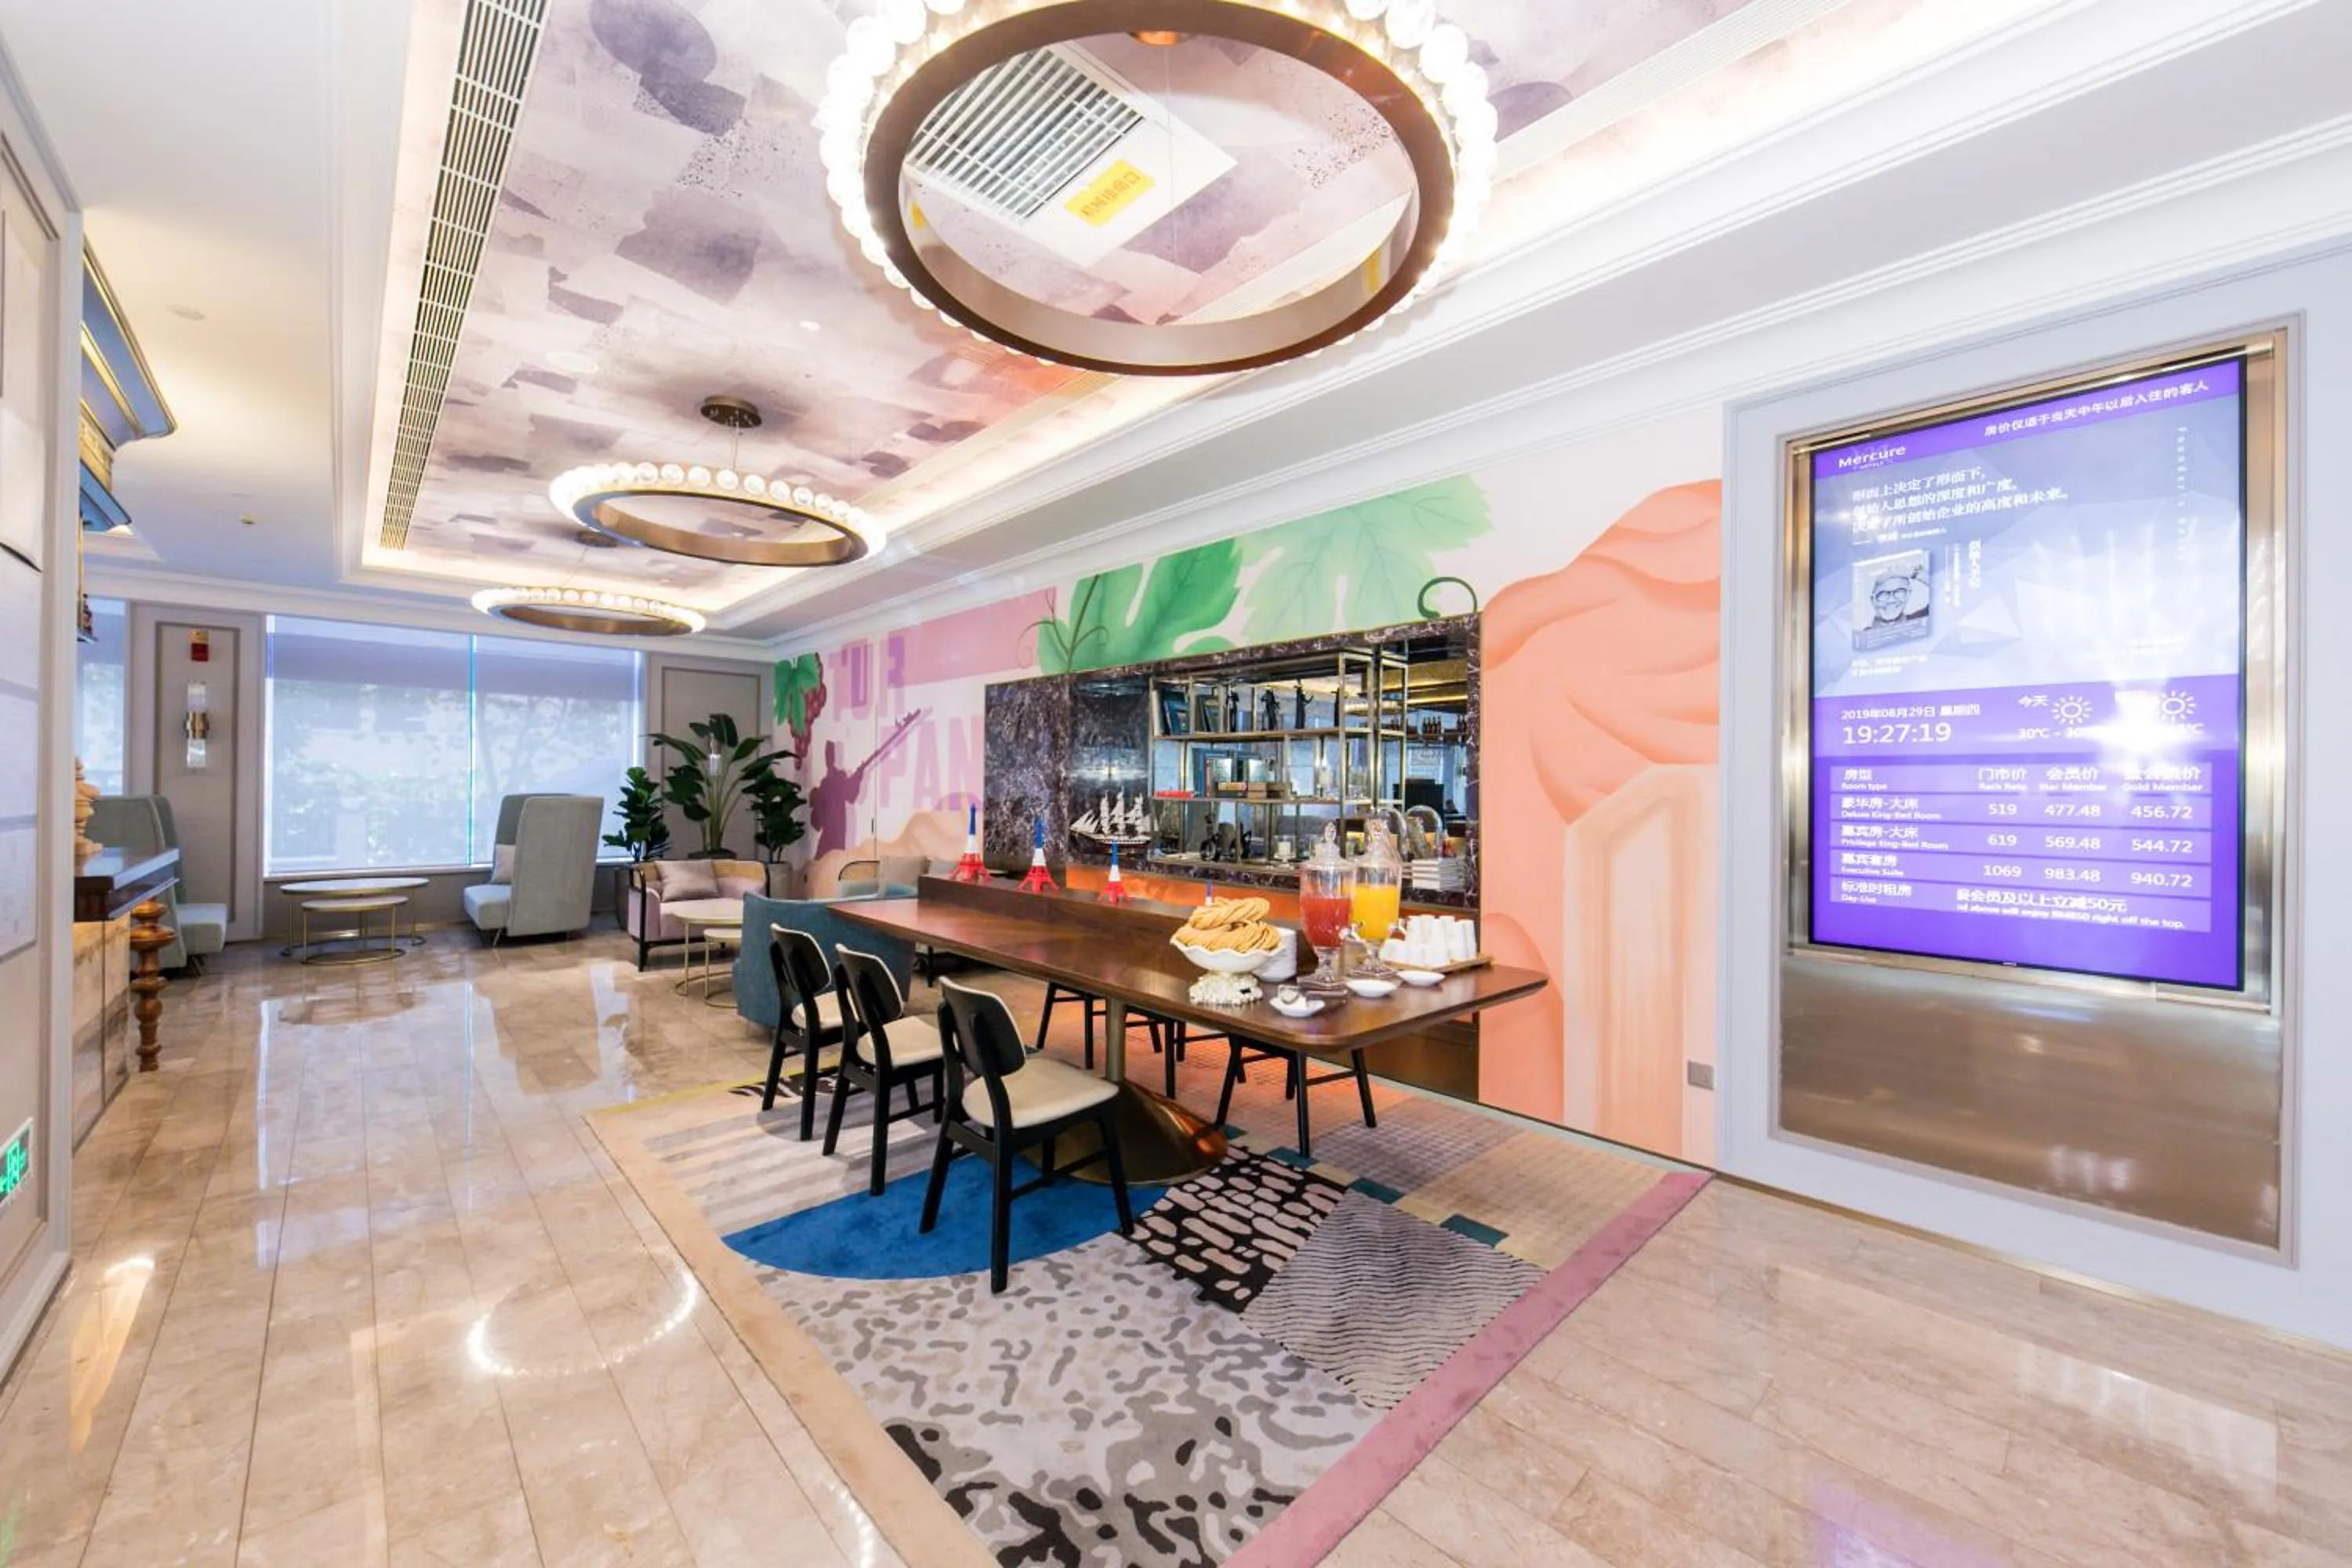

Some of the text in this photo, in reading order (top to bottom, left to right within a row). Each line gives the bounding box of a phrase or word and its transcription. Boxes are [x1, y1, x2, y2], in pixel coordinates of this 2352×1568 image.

[1838, 445, 1907, 469] Mercure
[2018, 694, 2050, 708] 今天
[1843, 722, 1951, 745] 19:27:19
[1843, 768, 1873, 780] 房型
[1978, 768, 2027, 781] 门市价
[2045, 767, 2099, 781] 会员价
[2062, 783, 2107, 792] Member
[2122, 782, 2204, 792] Gold Member
[1988, 804, 2017, 816] 519
[2045, 804, 2101, 818] 477.48
[2132, 805, 2193, 819] 456.72
[1988, 834, 2017, 848] 619
[2045, 837, 2101, 851] 569.48
[2132, 839, 2193, 854] 544.72
[1984, 865, 2022, 878] 1069
[2045, 868, 2101, 883] 983.48
[2131, 873, 2193, 888] 940.72
[2140, 916, 2160, 927] the
